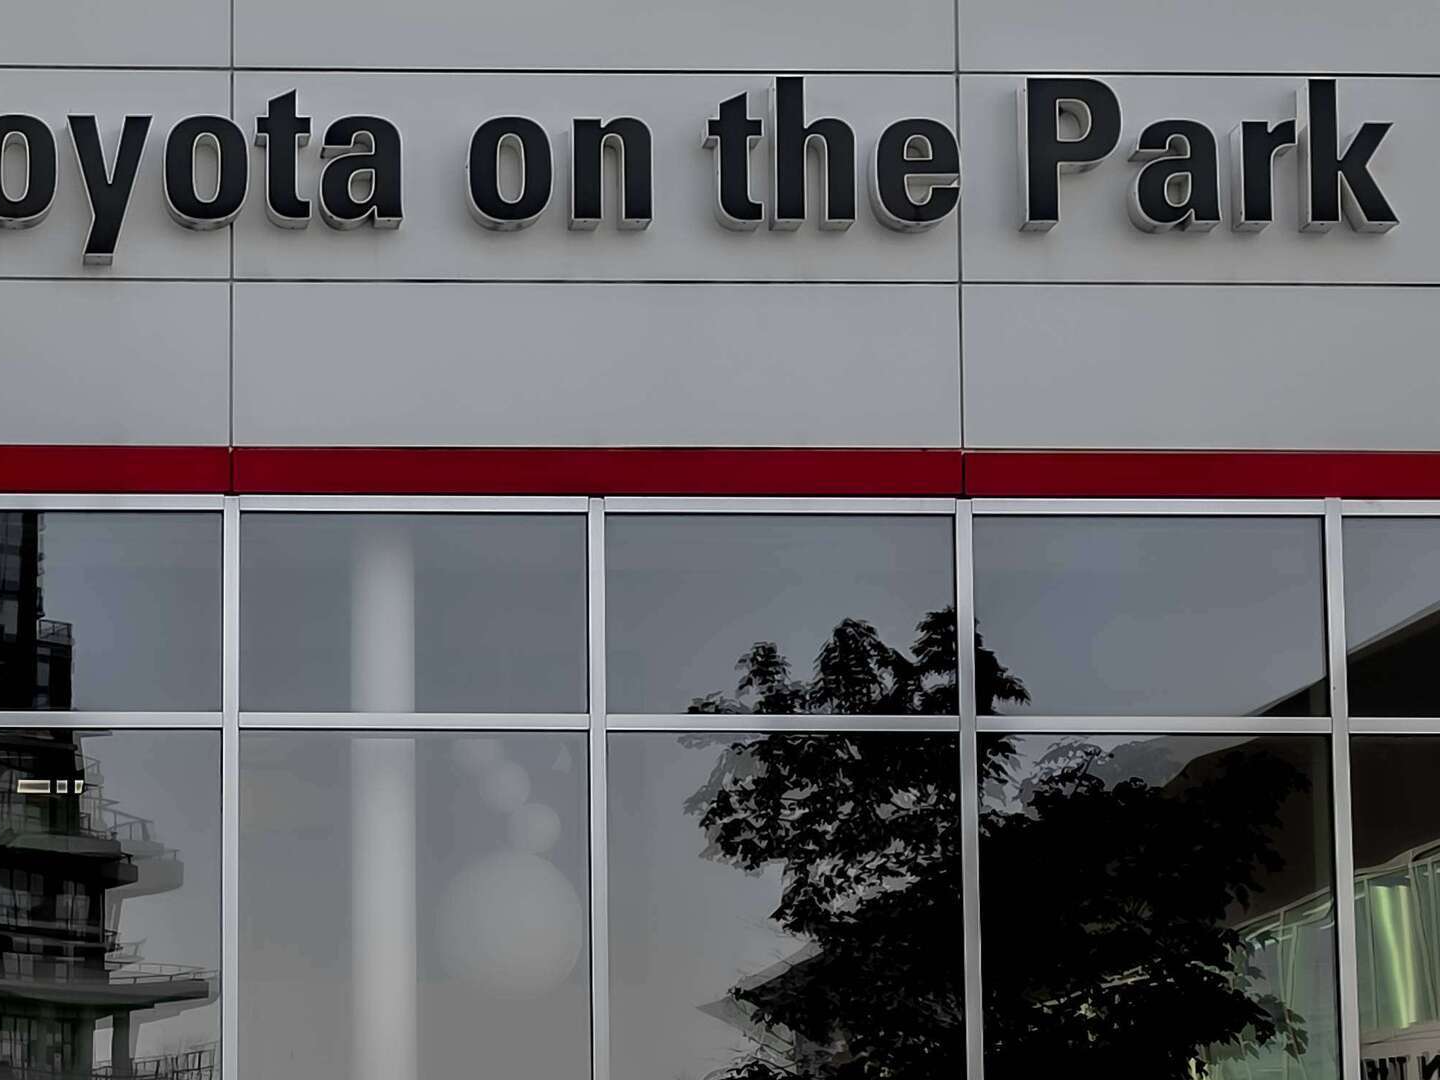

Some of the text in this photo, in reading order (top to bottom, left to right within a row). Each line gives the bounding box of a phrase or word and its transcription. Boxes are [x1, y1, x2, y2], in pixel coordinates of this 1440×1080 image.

[466, 115, 653, 230] on
[704, 76, 961, 231] the
[1018, 77, 1399, 232] Park
